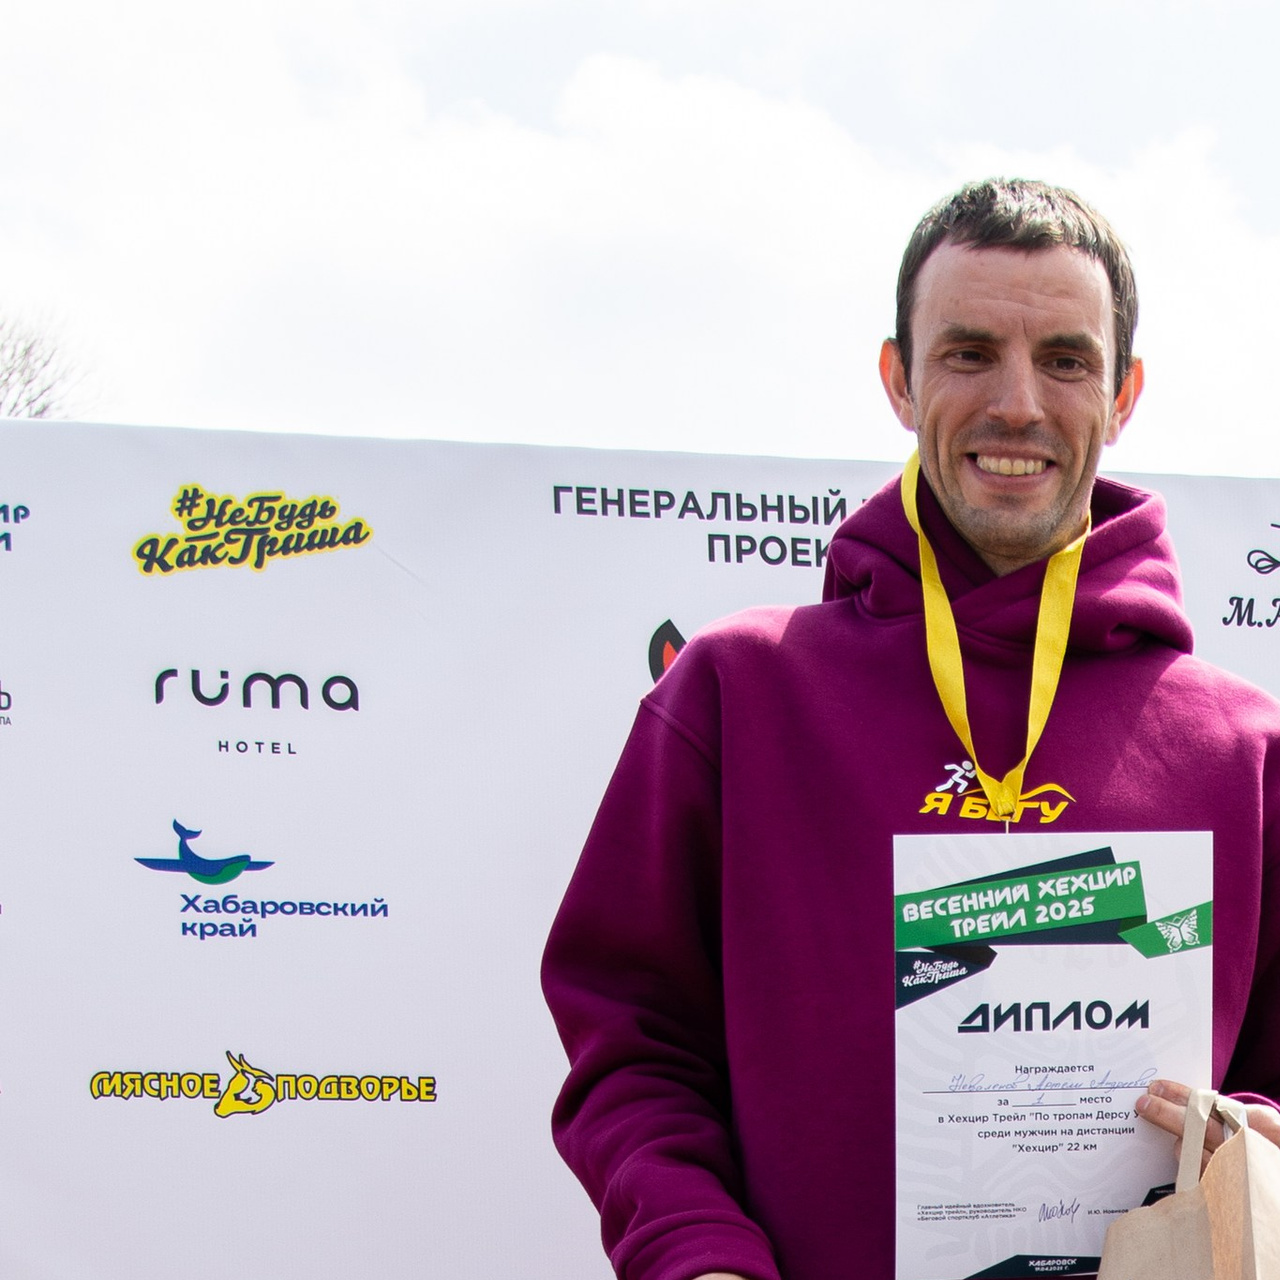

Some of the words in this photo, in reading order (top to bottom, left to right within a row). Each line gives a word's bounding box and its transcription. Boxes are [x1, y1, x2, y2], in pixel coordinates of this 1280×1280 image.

[175, 487, 337, 531] #НеБудь
[553, 486, 847, 526] ГЕНЕРАЛЬНЫЙ
[136, 521, 370, 574] КакГриша
[218, 740, 297, 755] HOTEL
[919, 792, 953, 815] Я
[959, 796, 1069, 823] БГУ
[180, 894, 389, 919] Хабаровский
[903, 883, 1030, 922] ВЕСЕННИЙ
[1038, 866, 1136, 899] ХЕХЦИР
[182, 918, 257, 941] край
[950, 909, 1027, 938] ТРЕЙЛ
[1035, 897, 1095, 924] 2025
[958, 1000, 1149, 1033] ДИПЛОМ
[1015, 1065, 1095, 1075] Награждается
[90, 1071, 222, 1101] МЯСНОЕ
[276, 1074, 437, 1103] ПОДВОРЬЕ
[997, 1098, 1009, 1106] за
[1080, 1096, 1112, 1104] место
[947, 1114, 989, 1125] Хехцир
[992, 1113, 1026, 1123] Трейл
[1029, 1112, 1049, 1121] "По
[1053, 1112, 1093, 1123] тропам
[1096, 1110, 1130, 1121] Дерсу
[978, 1129, 1011, 1139] среди
[1014, 1128, 1057, 1138] мужчин
[1061, 1128, 1073, 1136] на
[1076, 1126, 1135, 1137] дистанции
[1012, 1143, 1064, 1153] "Хехцир"
[1067, 1143, 1080, 1151] 22
[1028, 1259, 1077, 1267] ХАБАРОВСК
